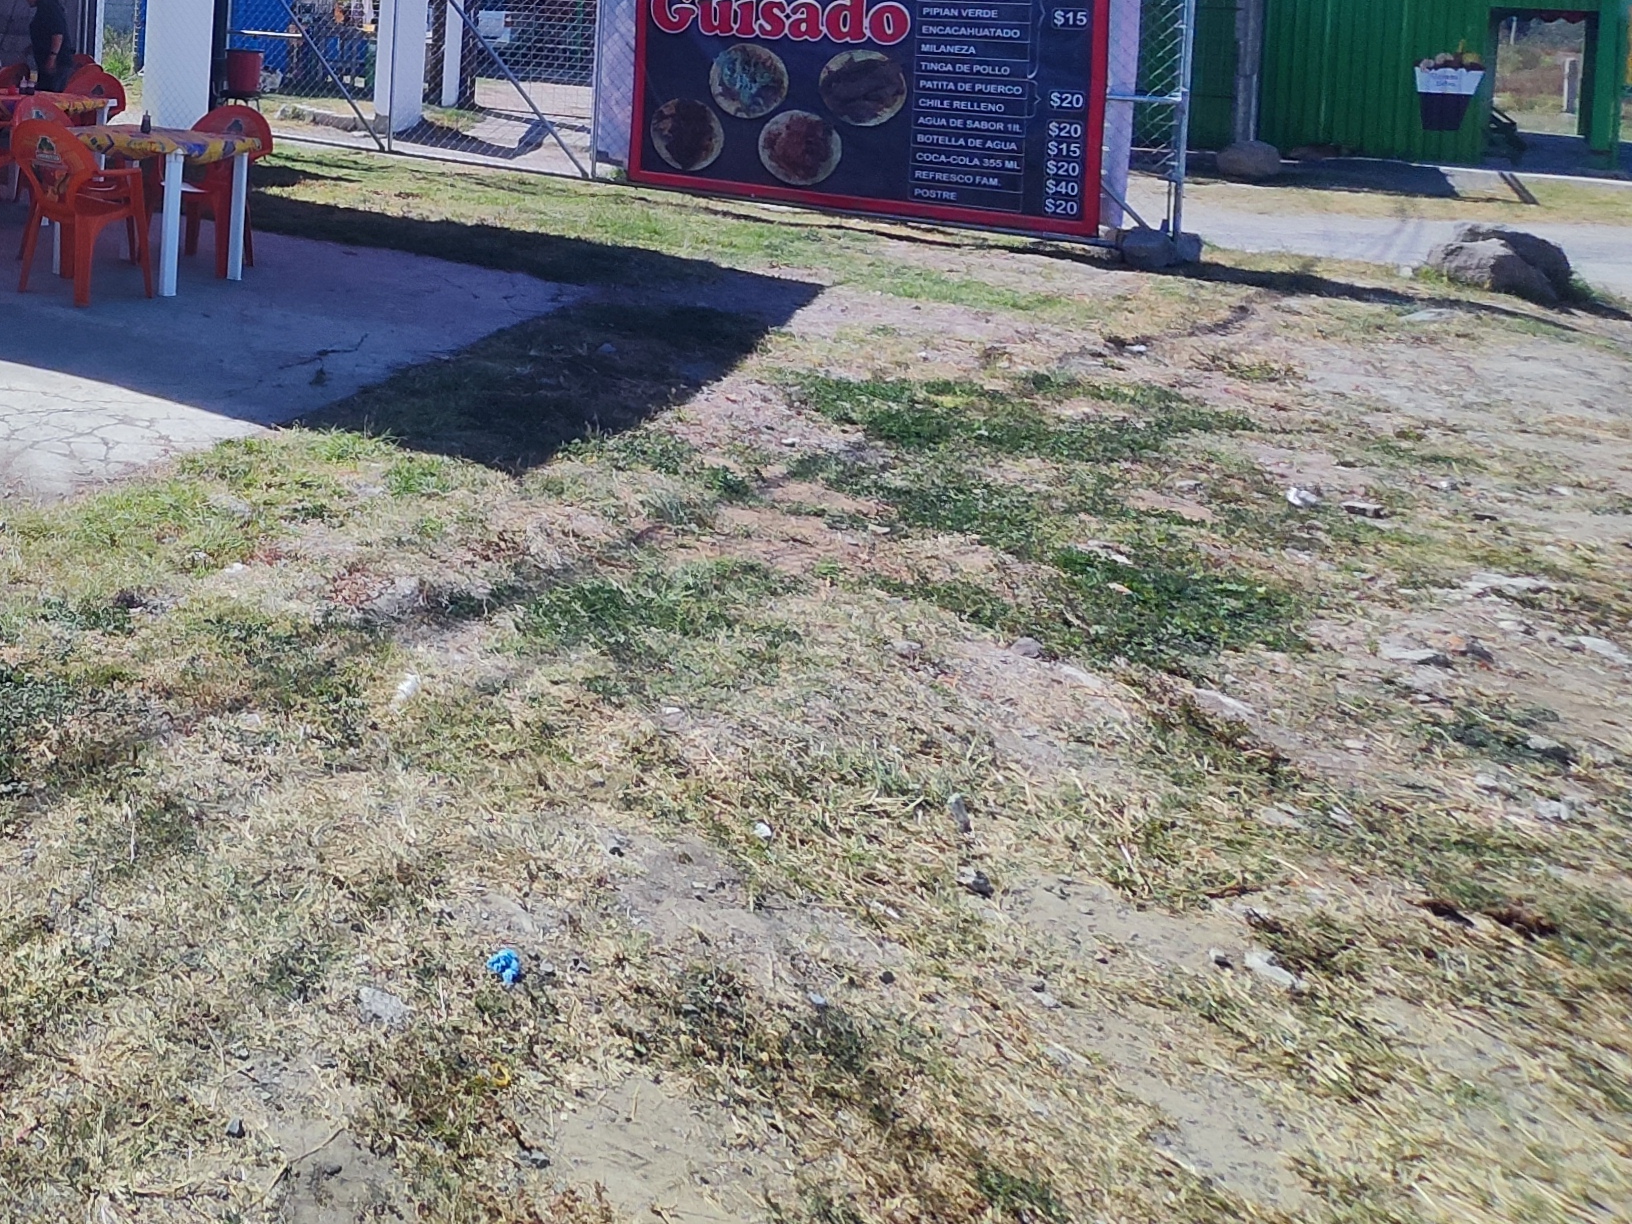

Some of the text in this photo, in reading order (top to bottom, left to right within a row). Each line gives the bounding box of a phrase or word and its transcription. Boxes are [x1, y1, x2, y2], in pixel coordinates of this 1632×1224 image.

[922, 7, 998, 18] PIPIAN VERDE
[1053, 9, 1087, 28] $15
[921, 25, 1021, 38] ENCACAHUATADO
[921, 43, 976, 55] MILANEZA
[920, 61, 1010, 75] TINGA DE POLLO
[919, 79, 1022, 95] PATITA DE PUERCO
[918, 98, 1005, 112] CHILE RELLENO
[1050, 92, 1084, 110] $20
[917, 116, 947, 126] AGUA
[949, 118, 964, 128] DE
[966, 119, 1004, 131] SABOR
[1048, 121, 1081, 139] $20
[917, 133, 1018, 151] BOTELLA DE AGUA
[1047, 141, 1081, 158] $15
[915, 152, 1021, 169] COCA-COLA 355 ML
[1046, 160, 1079, 178] $20
[915, 170, 1001, 186] REFRESCO FAM.
[914, 188, 958, 200] POSTRE
[1045, 178, 1078, 197] $40
[1044, 197, 1078, 215] $20
